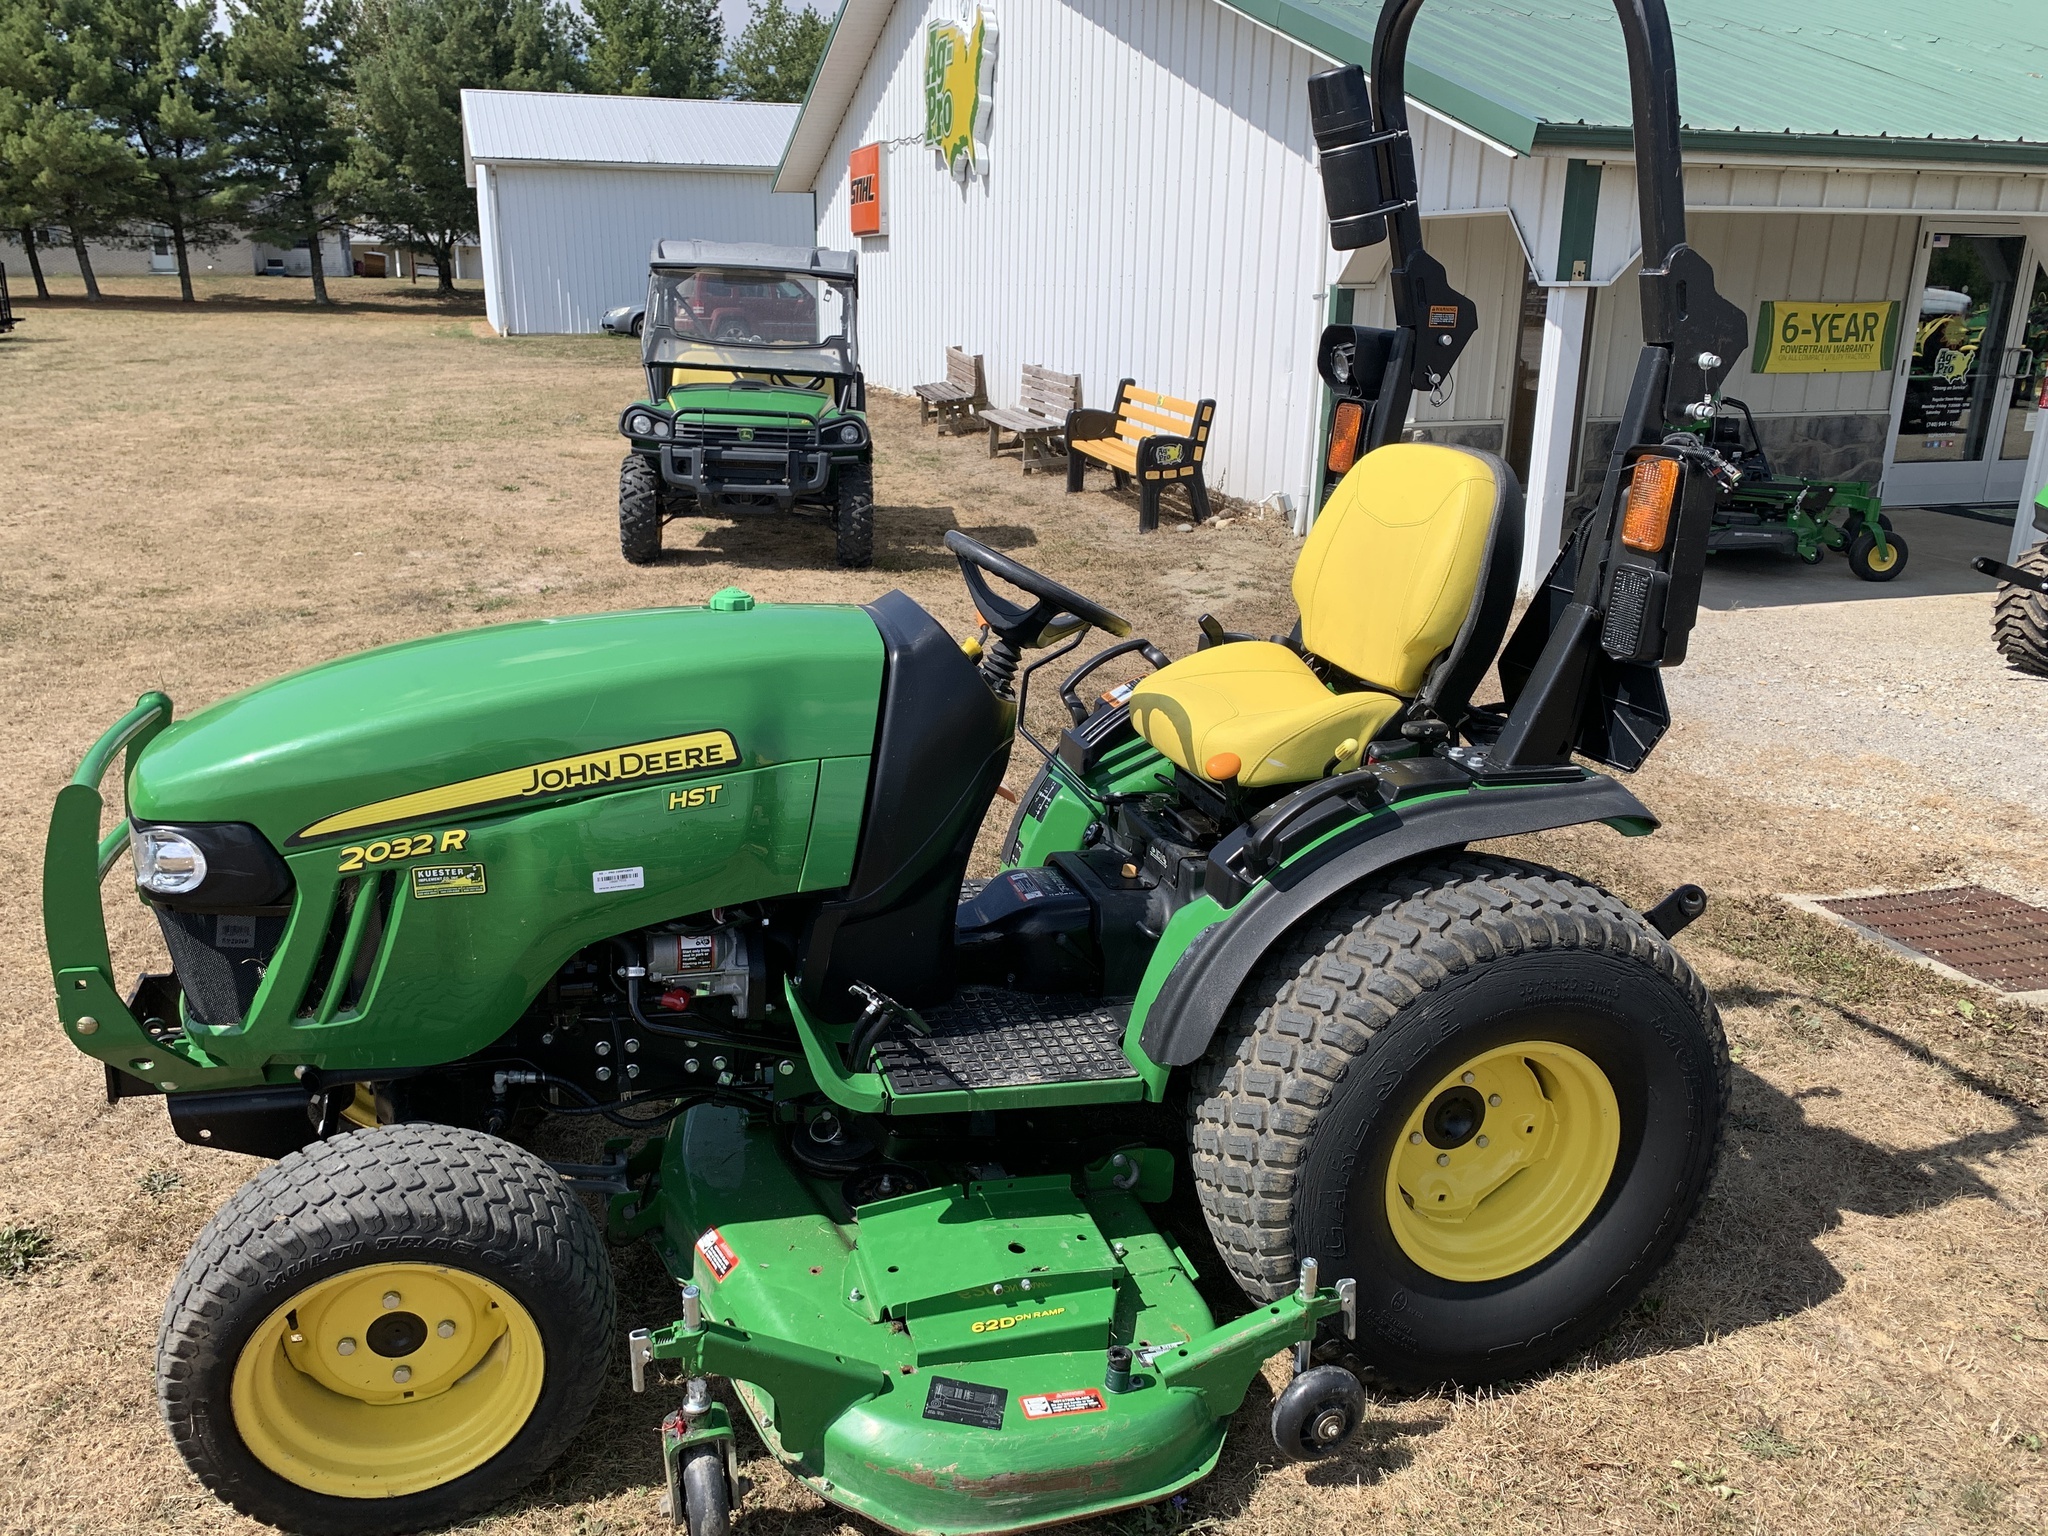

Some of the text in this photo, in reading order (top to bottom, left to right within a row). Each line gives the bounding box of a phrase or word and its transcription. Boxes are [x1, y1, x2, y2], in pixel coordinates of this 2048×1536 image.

[851, 174, 875, 206] STIHL
[1781, 312, 1879, 343] 6-YEAR
[1780, 344, 1874, 354] POWERTRAIN WARRANTY
[1937, 363, 1954, 374] Pro
[522, 744, 724, 793] JOHN DEERE
[669, 784, 723, 811] HST
[338, 829, 467, 872] 2032 R
[417, 868, 464, 878] KUESTER
[263, 1240, 364, 1293] MULTI
[971, 1307, 1066, 1334] 62D ON RAMP
